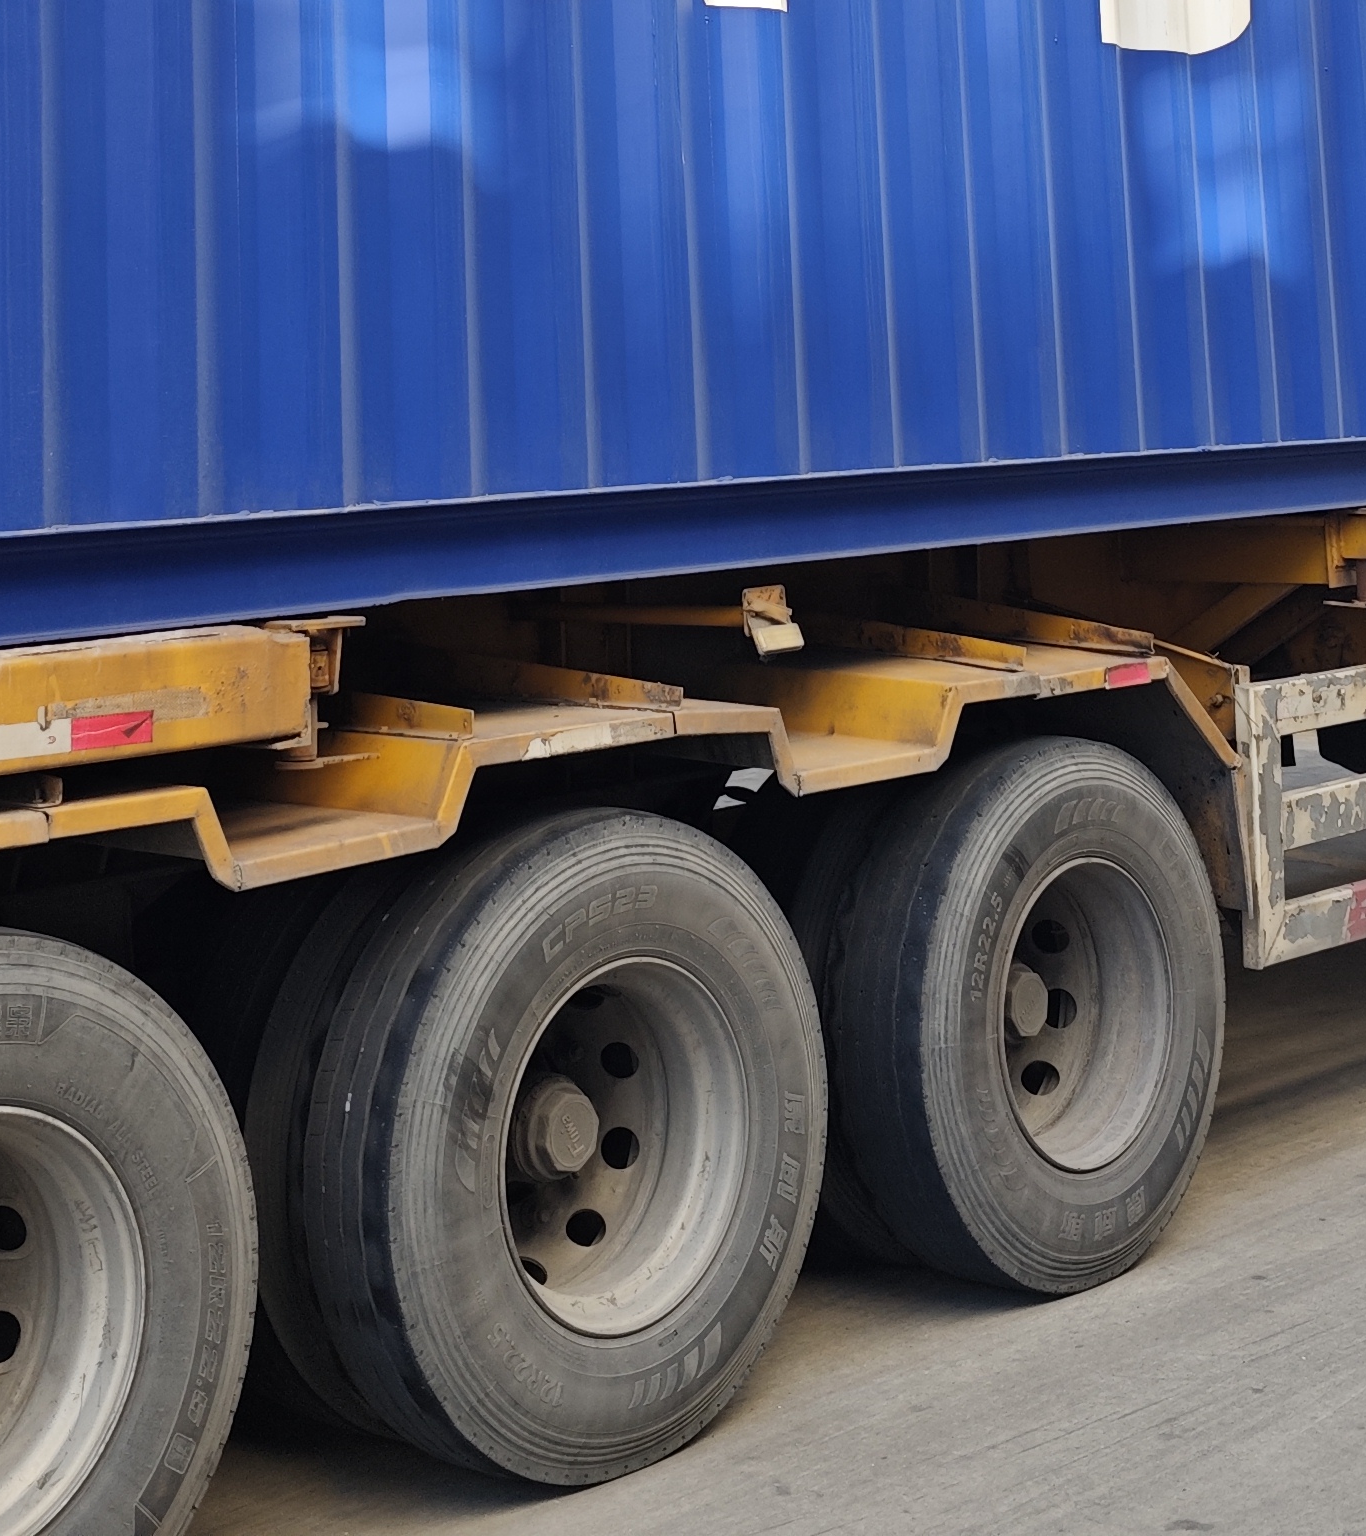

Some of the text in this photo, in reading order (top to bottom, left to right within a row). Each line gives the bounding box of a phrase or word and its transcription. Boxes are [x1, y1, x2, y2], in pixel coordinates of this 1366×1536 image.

[969, 891, 1003, 1002] 12R22.5
[132, 1149, 159, 1201] STEEL
[561, 1114, 585, 1157] Fuwa
[188, 1220, 226, 1427] 12R22.5
[487, 1322, 563, 1408] 12R22.5
